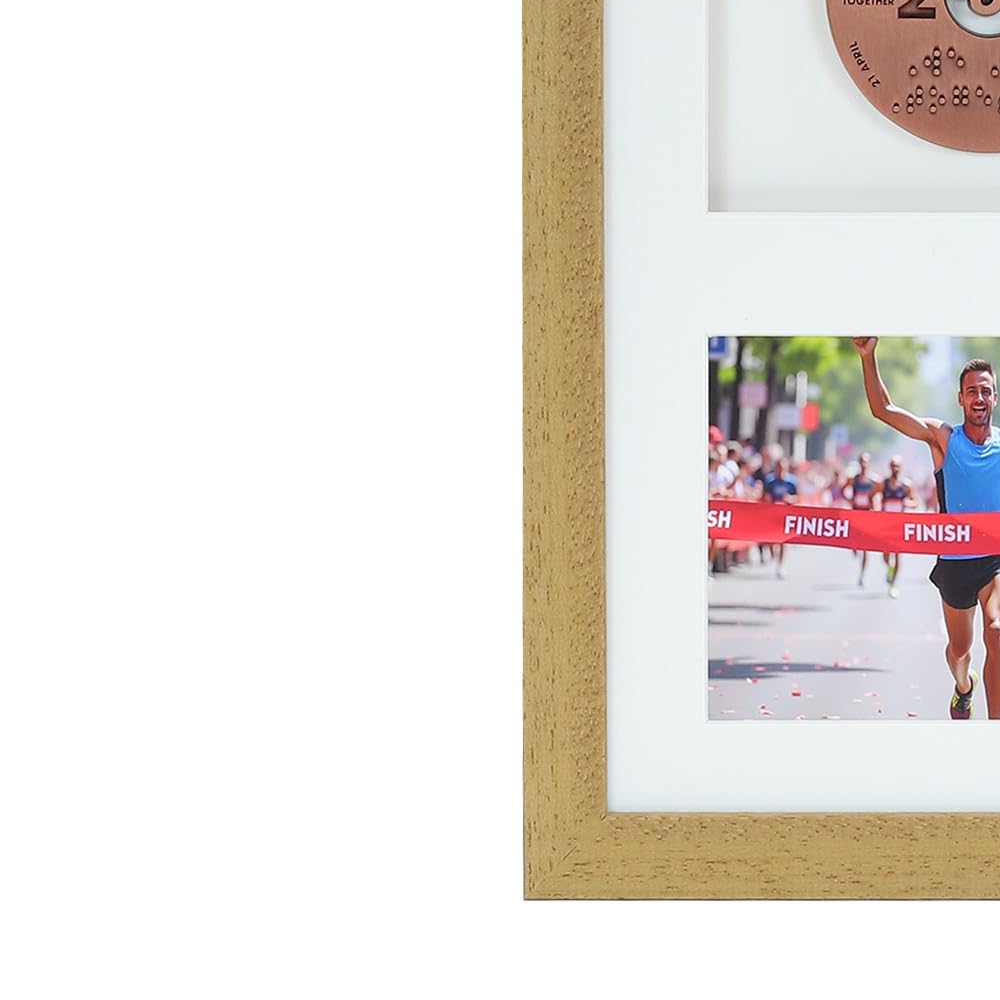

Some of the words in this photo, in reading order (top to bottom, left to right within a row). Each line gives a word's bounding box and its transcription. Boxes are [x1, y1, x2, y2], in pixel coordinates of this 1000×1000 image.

[849, 41, 871, 71] APRIL
[867, 73, 881, 88] 21
[784, 515, 850, 538] FINISH
[903, 523, 971, 542] FINISH
